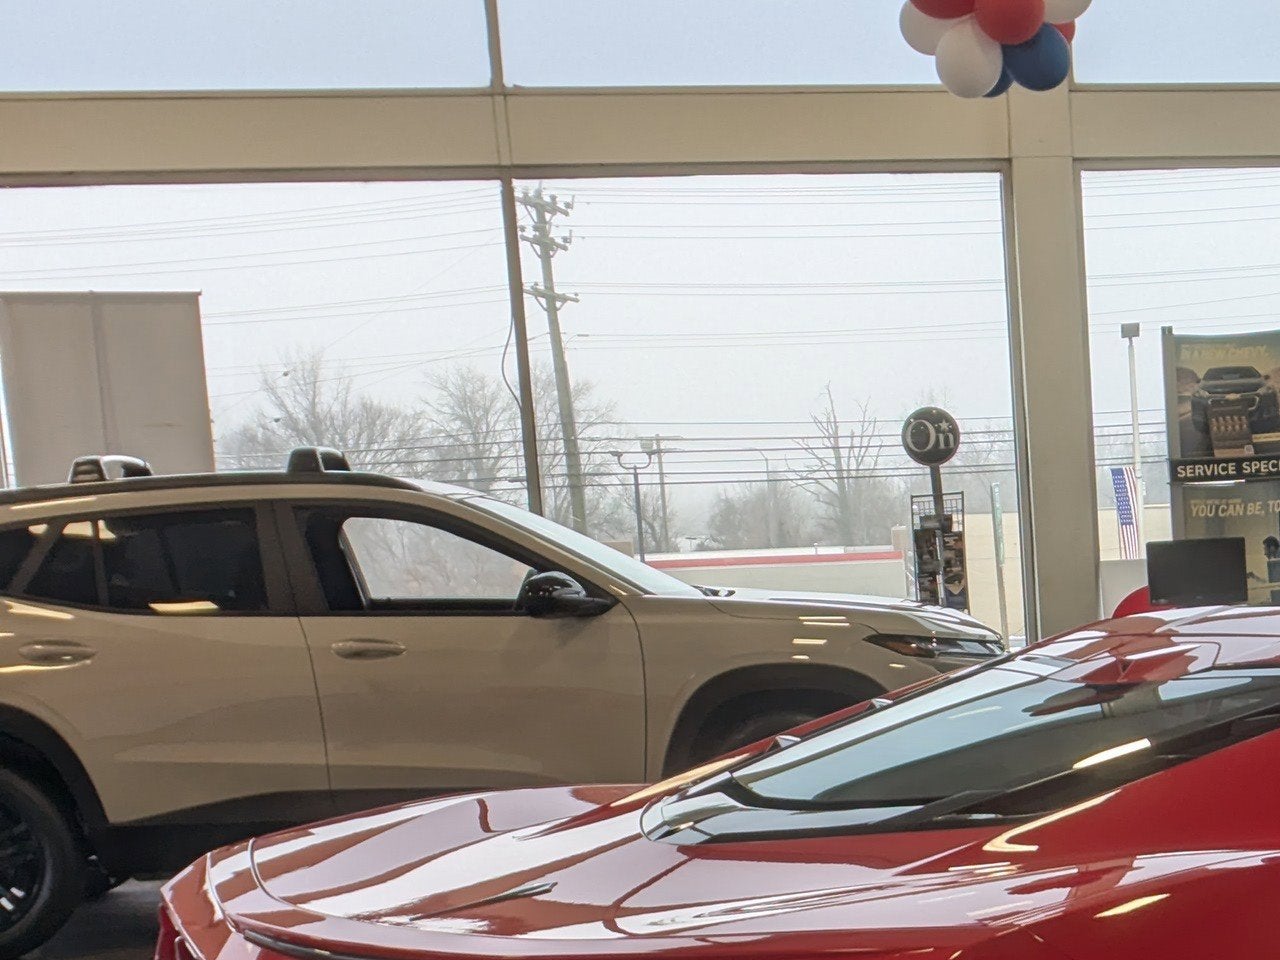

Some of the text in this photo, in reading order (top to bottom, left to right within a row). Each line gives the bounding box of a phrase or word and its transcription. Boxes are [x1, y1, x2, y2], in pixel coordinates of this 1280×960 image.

[906, 419, 955, 452] On
[1177, 462, 1236, 478] SERVICE
[1190, 504, 1216, 517] YOU
[1218, 503, 1244, 517] CAN
